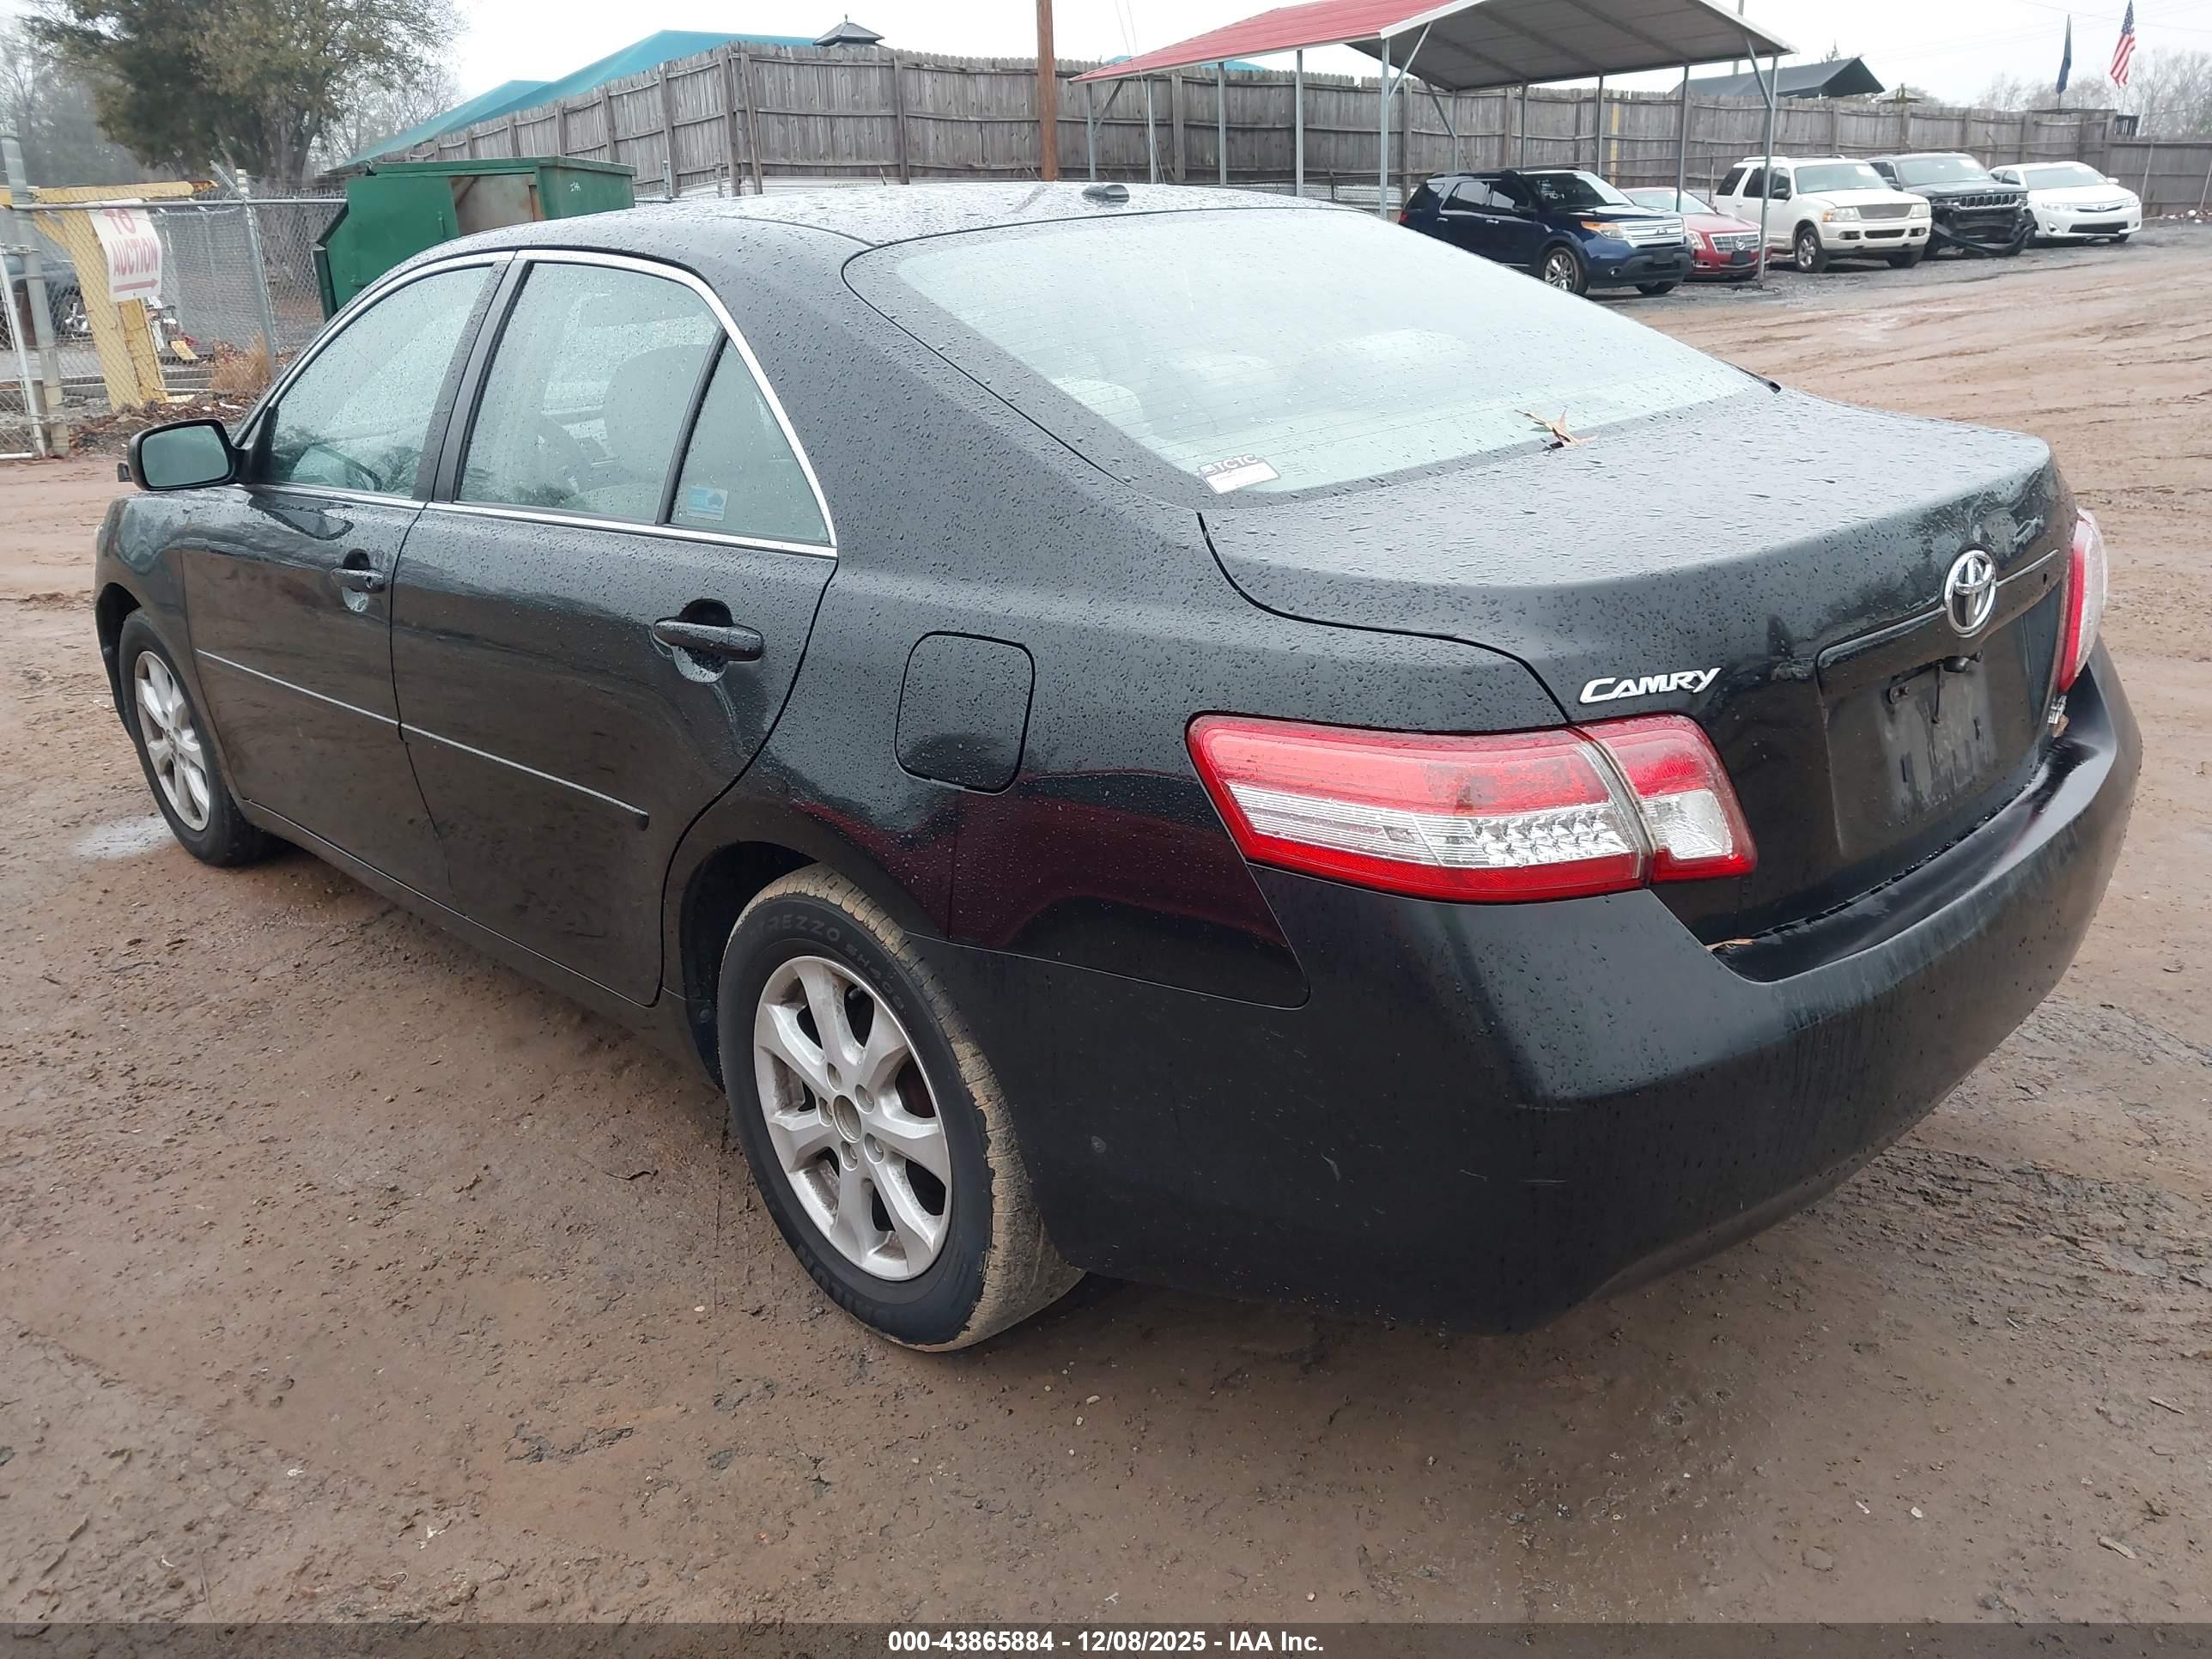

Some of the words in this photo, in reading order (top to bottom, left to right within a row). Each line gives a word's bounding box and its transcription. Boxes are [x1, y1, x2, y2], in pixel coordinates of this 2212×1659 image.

[103, 208, 137, 234] TO
[109, 237, 158, 276] AUCTION
[1579, 666, 1723, 704] CAMRY
